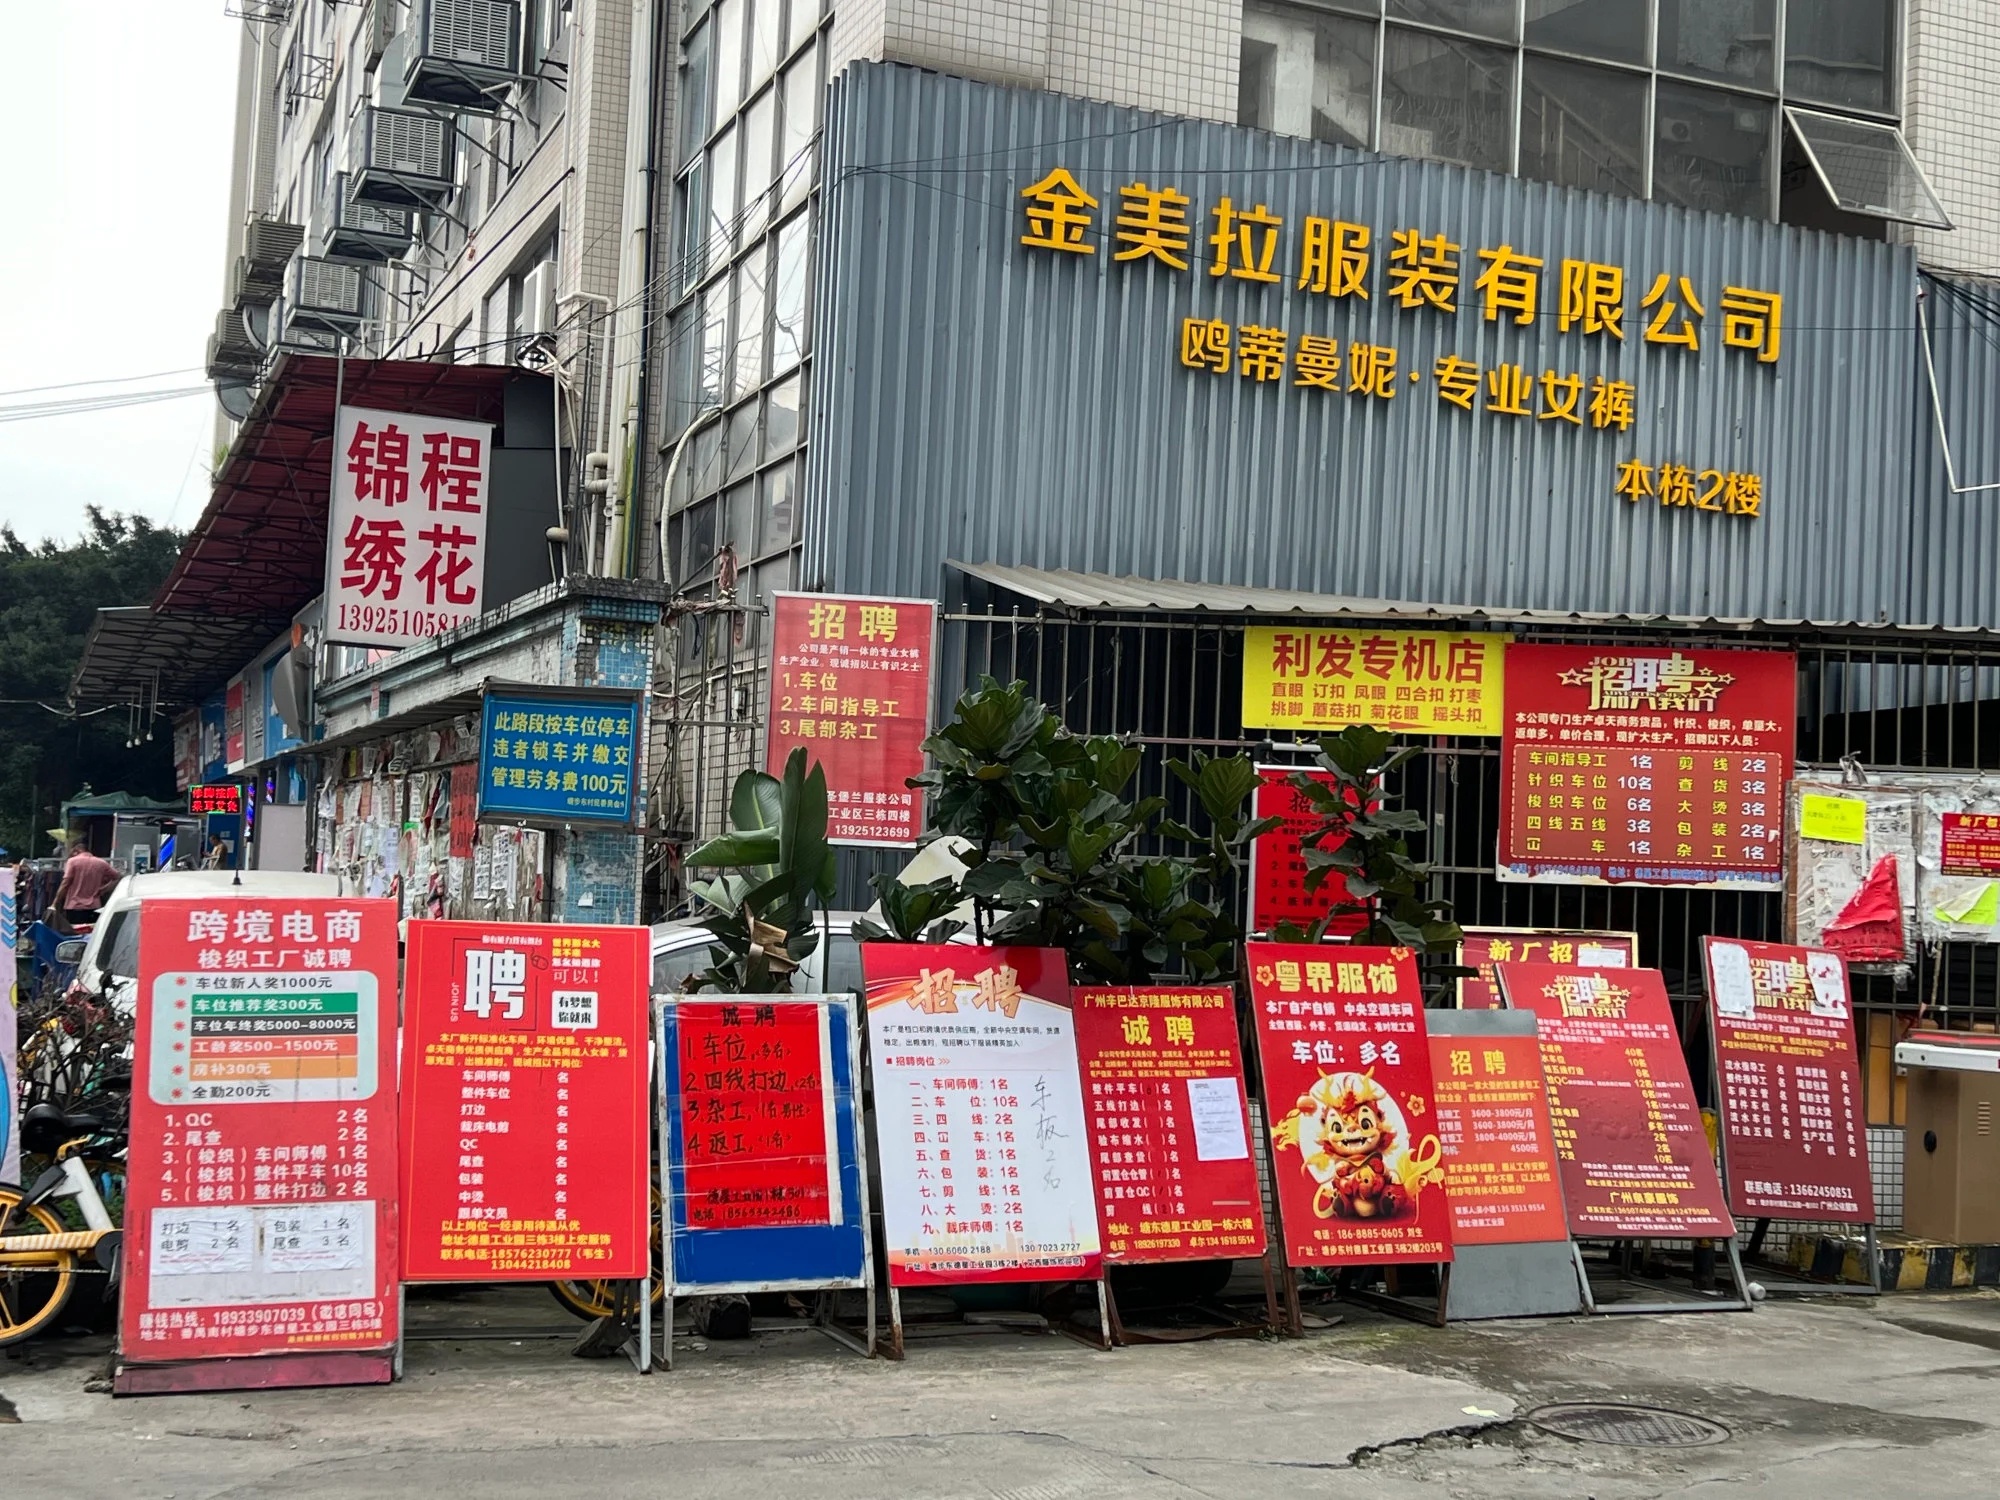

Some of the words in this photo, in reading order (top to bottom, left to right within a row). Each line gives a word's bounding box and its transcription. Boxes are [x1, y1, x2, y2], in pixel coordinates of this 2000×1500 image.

[1020, 167, 1783, 363] 金美拉服装有限公司
[348, 420, 482, 514] 锦程
[1615, 459, 1762, 517] 本栋2楼
[340, 515, 477, 606] 绣花
[808, 602, 898, 643] 招聘
[1272, 633, 1486, 685] 利发专机店
[1588, 656, 1634, 666] JOB
[782, 672, 838, 691] 1.车位
[1581, 652, 1719, 711] 招聘
[1272, 682, 1303, 698] 直眼
[1313, 683, 1345, 699] 订扣
[1354, 684, 1386, 700] 凤眼
[1396, 686, 1444, 703] 四合扣
[1449, 687, 1482, 704] 打枣
[780, 696, 899, 718] 2.车间指导工
[1271, 701, 1303, 717] 挑脚
[1312, 702, 1361, 719] 蘑菇扣
[1371, 704, 1419, 721] 菊花眼
[1433, 706, 1482, 722] 摇头扣
[494, 711, 630, 739] 此路段按车位停车
[780, 720, 878, 740] 3.尾部杂工
[493, 738, 629, 766] 违者锁车并缴交
[1529, 752, 1607, 767] 车间指导工
[1630, 755, 1653, 770] 1名
[1742, 758, 1766, 773] 2名
[492, 766, 627, 795] 管理劳务费100元
[1528, 773, 1607, 789] 针织车位
[1618, 776, 1652, 791] 10名
[1741, 780, 1766, 795] 3名
[1527, 795, 1607, 810] 梭织车位
[1627, 797, 1652, 812] 6名
[1741, 802, 1765, 817] 3名
[835, 824, 911, 838] 13925123699
[1527, 816, 1607, 832] 四线五线
[1627, 818, 1651, 833] 3名
[1740, 824, 1765, 838] 2名
[1628, 840, 1651, 855] 1名
[1742, 846, 1765, 860] 1名
[187, 909, 363, 944] 跨境电商
[198, 948, 353, 969] 梭织工厂诚聘
[195, 974, 333, 990] 车位新人奖1000元
[463, 948, 527, 1020] 聘
[1274, 960, 1398, 995] 粤界服饰
[450, 982, 460, 1006] JOIN
[906, 967, 1022, 1019] 招聘
[194, 997, 324, 1012] 车位推荐奖300元
[559, 996, 592, 1009] 有梦想
[1266, 1000, 1336, 1016] 本厂自产自销
[1344, 1002, 1414, 1017] 中央空调车间
[450, 1007, 460, 1022] US
[1121, 1015, 1195, 1047] 诚聘
[193, 1061, 272, 1077] 房补300元
[896, 1055, 935, 1067] 招聘岗位
[1450, 1050, 1506, 1076] 招聘
[462, 1071, 511, 1083] 车间师傅
[192, 1083, 271, 1100] 全勤200元
[461, 1087, 510, 1099] 整件车位
[337, 1108, 369, 1124] 2名
[460, 1104, 485, 1116] 打边
[337, 1126, 368, 1142] 2名
[460, 1121, 509, 1133] 裁床电剪
[338, 1144, 369, 1161] 1名
[460, 1138, 478, 1150] QC
[1511, 1143, 1539, 1153] 4500元
[332, 1162, 369, 1179] 10名
[459, 1156, 484, 1168] 尾查
[458, 1173, 484, 1185] 包装
[336, 1180, 369, 1197] 2名
[458, 1190, 484, 1203] 中烫
[458, 1207, 508, 1220] 跟单文员
[161, 1221, 189, 1235] 打边
[274, 1219, 301, 1232] 包装
[1061, 1243, 1081, 1252] 2727
[491, 1259, 571, 1270] 13044218408
